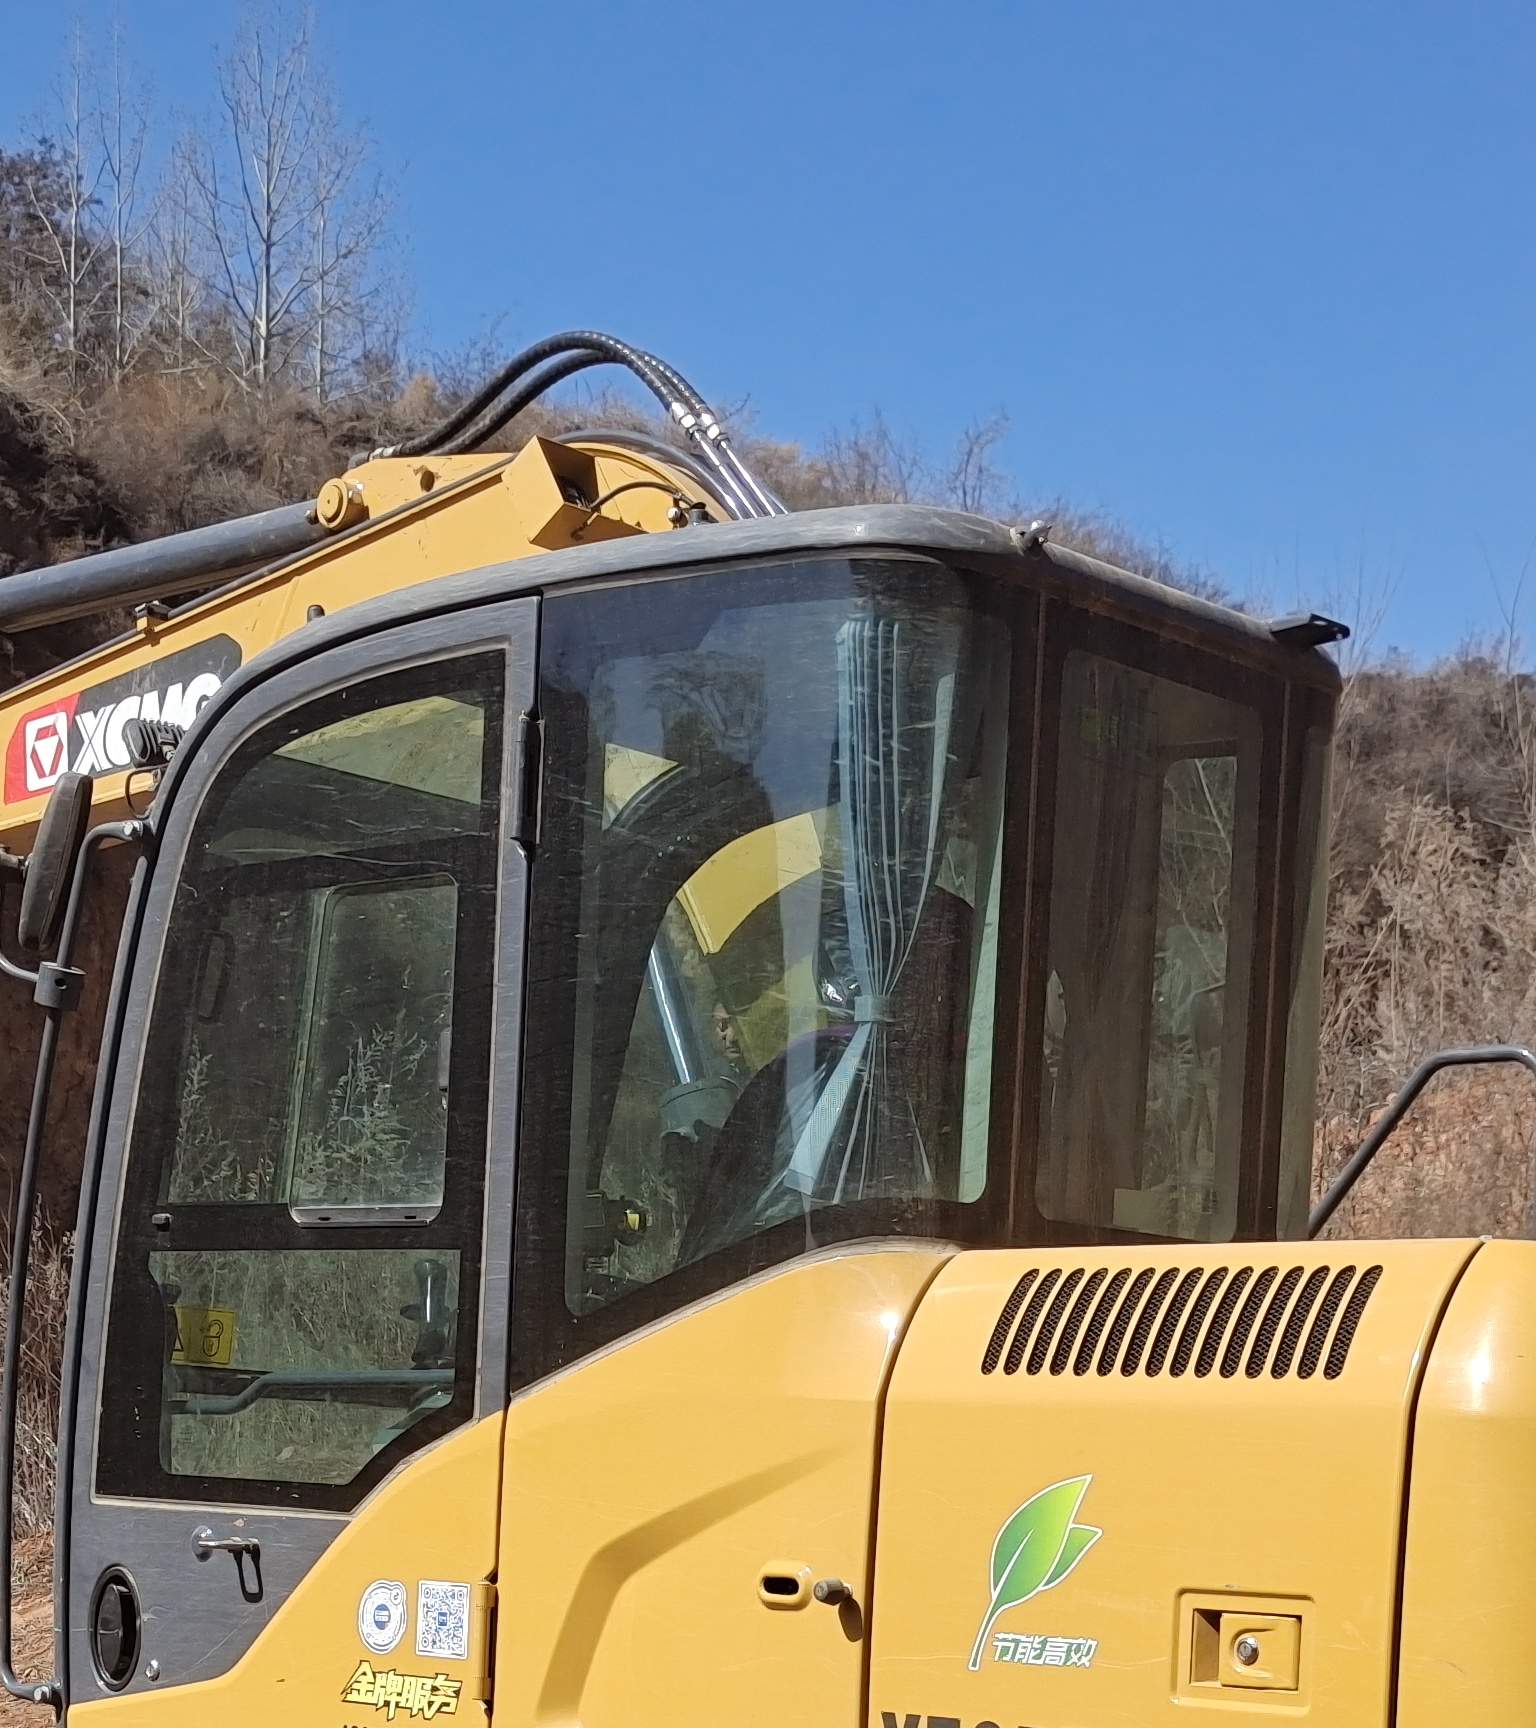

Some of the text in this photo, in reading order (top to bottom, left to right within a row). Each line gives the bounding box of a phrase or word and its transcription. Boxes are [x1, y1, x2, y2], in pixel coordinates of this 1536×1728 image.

[992, 1632, 1099, 1668] 节能高效
[340, 1659, 463, 1721] 金牌服务
